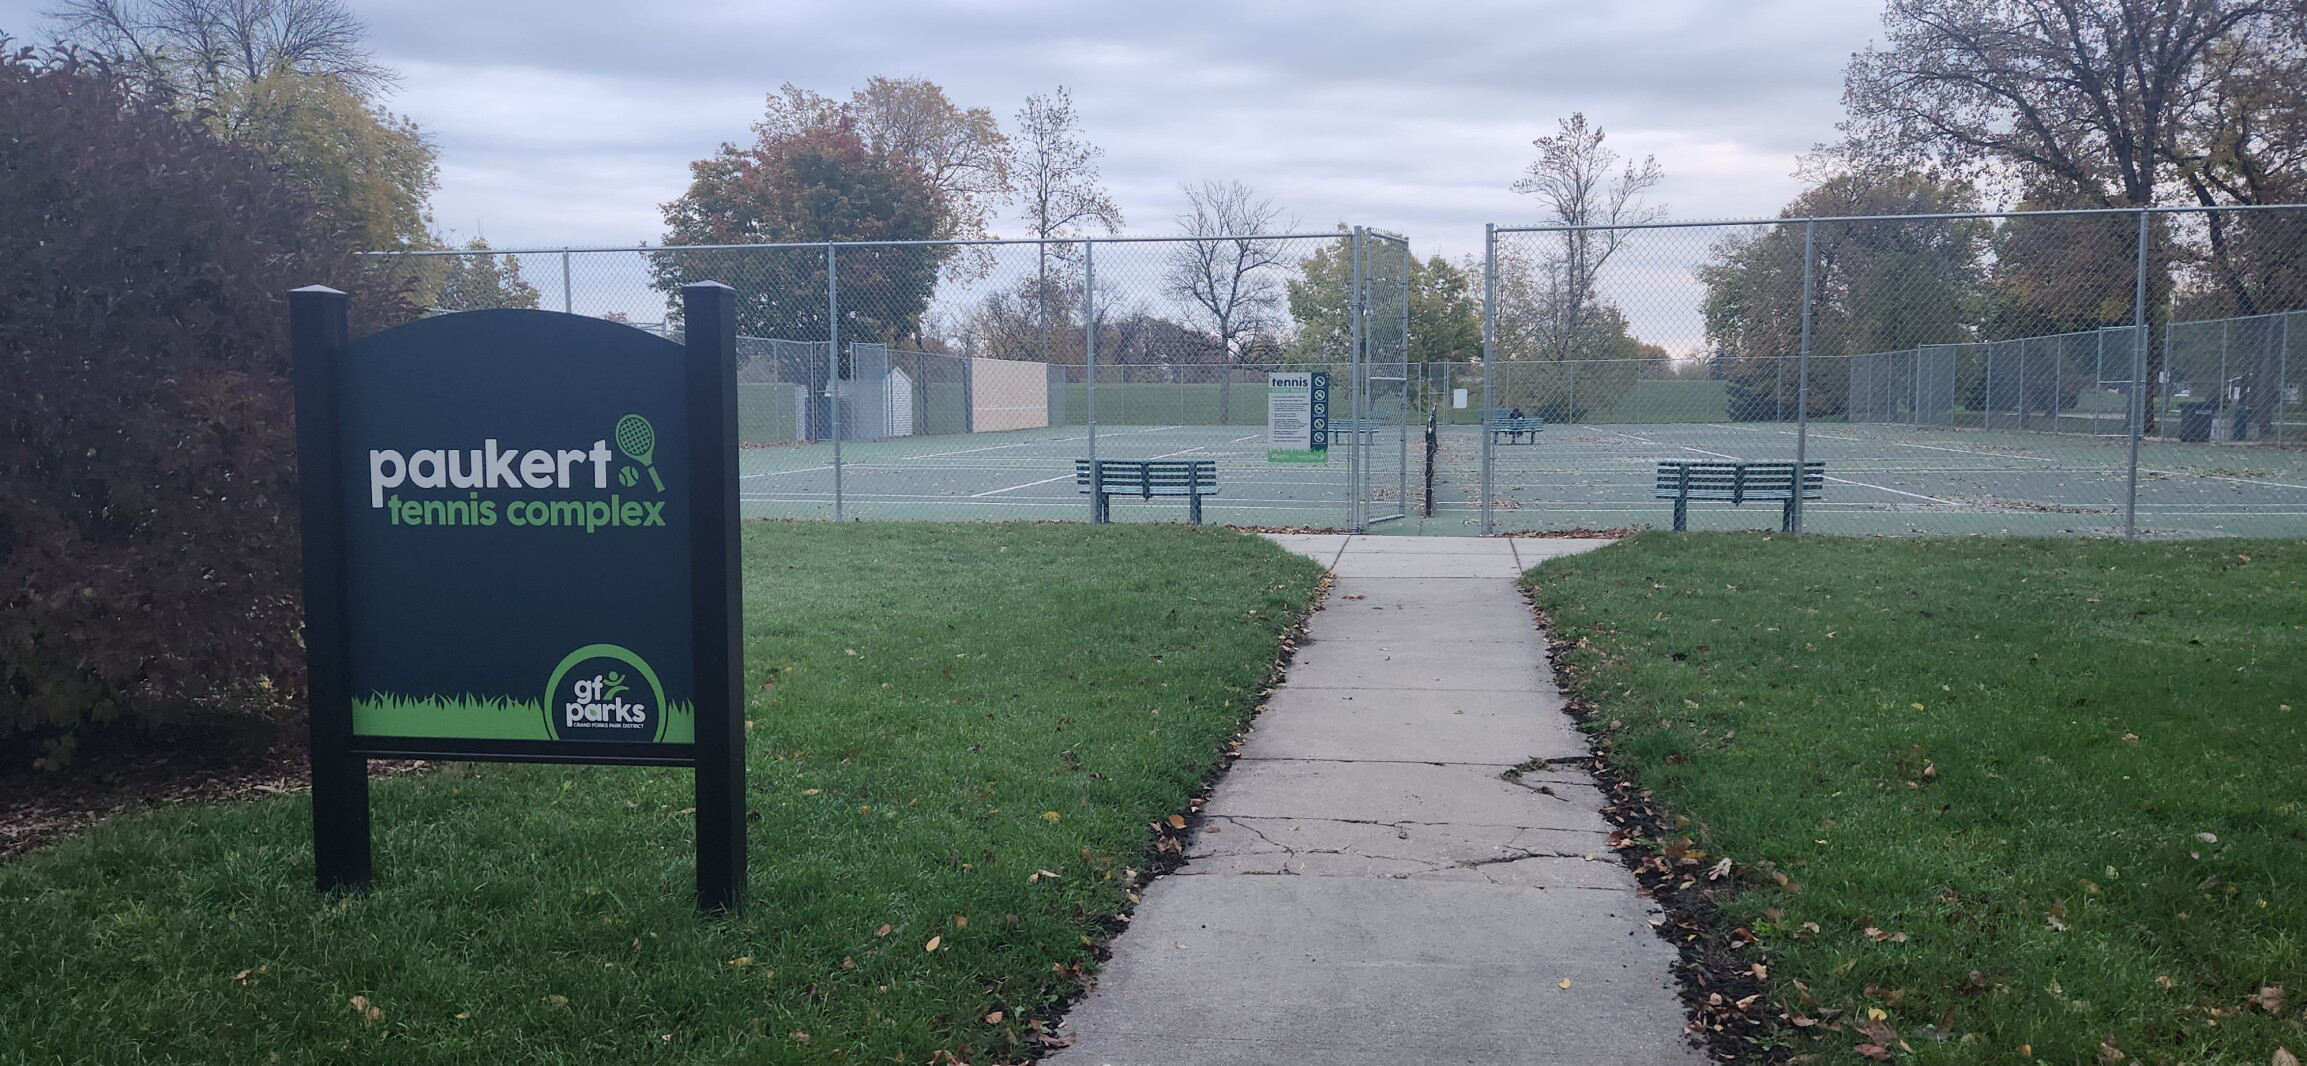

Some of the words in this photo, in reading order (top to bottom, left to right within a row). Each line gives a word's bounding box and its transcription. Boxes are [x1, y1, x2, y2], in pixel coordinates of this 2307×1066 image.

[1272, 377, 1308, 387] tennis
[369, 438, 612, 508] paukert
[388, 491, 498, 526] tennis
[506, 494, 666, 533] complex
[574, 674, 603, 705] gf
[565, 697, 646, 727] parks
